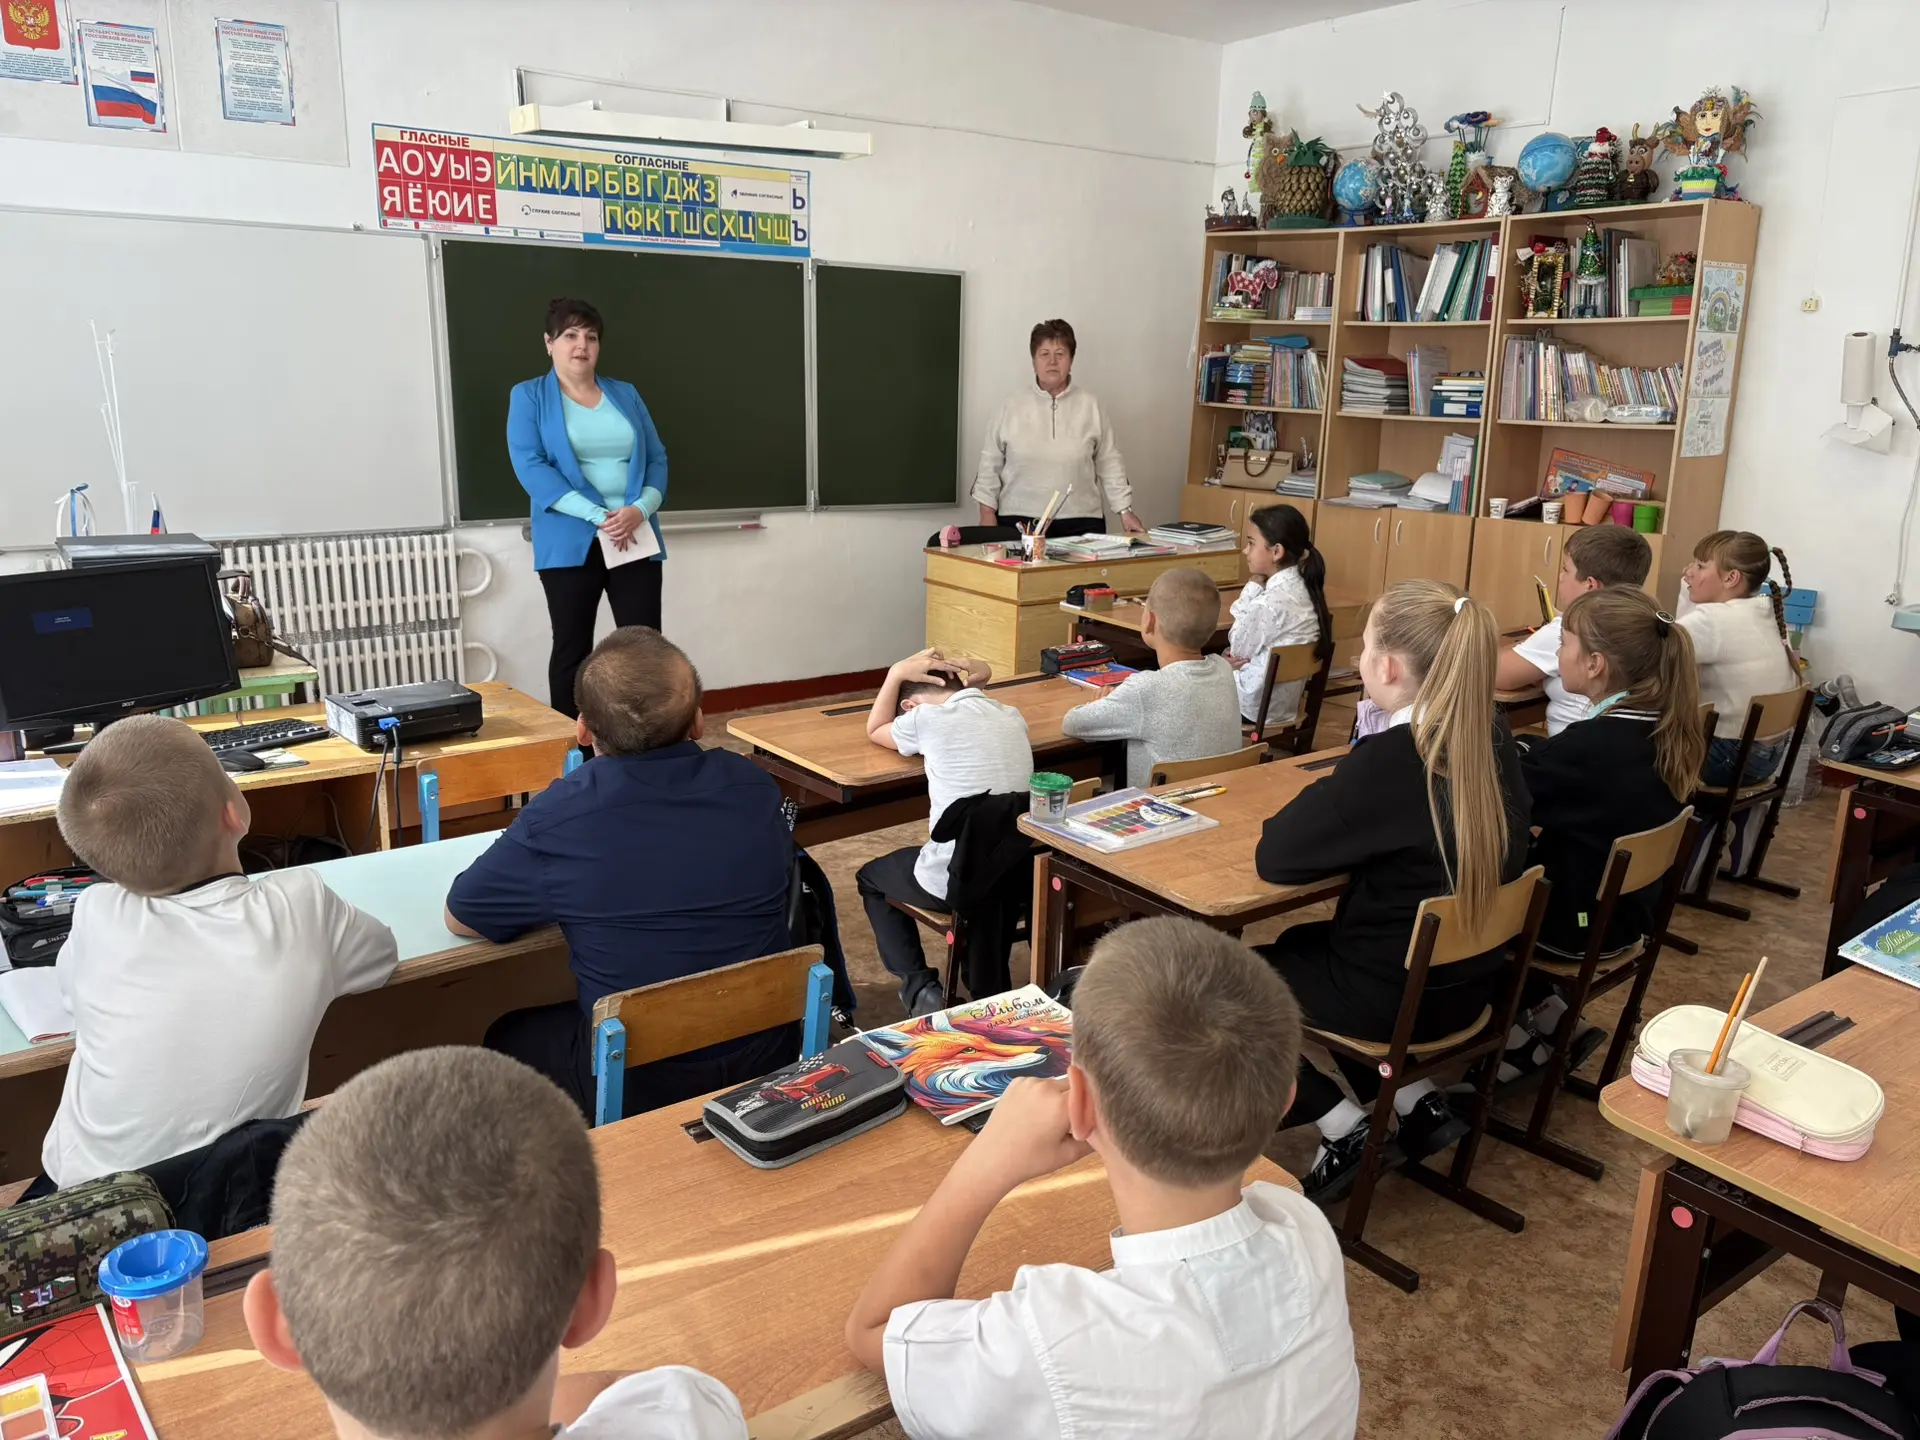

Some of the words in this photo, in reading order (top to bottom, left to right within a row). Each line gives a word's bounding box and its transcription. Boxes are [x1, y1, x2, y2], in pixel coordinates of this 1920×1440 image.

[400, 130, 470, 148] ГЛАСНЫЕ
[614, 154, 689, 171] СОГЛАСНЫЕ
[969, 997, 1046, 1020] Альбом
[986, 1019, 1006, 1032] для
[1007, 1007, 1058, 1025] рисования
[821, 1093, 846, 1109] KING
